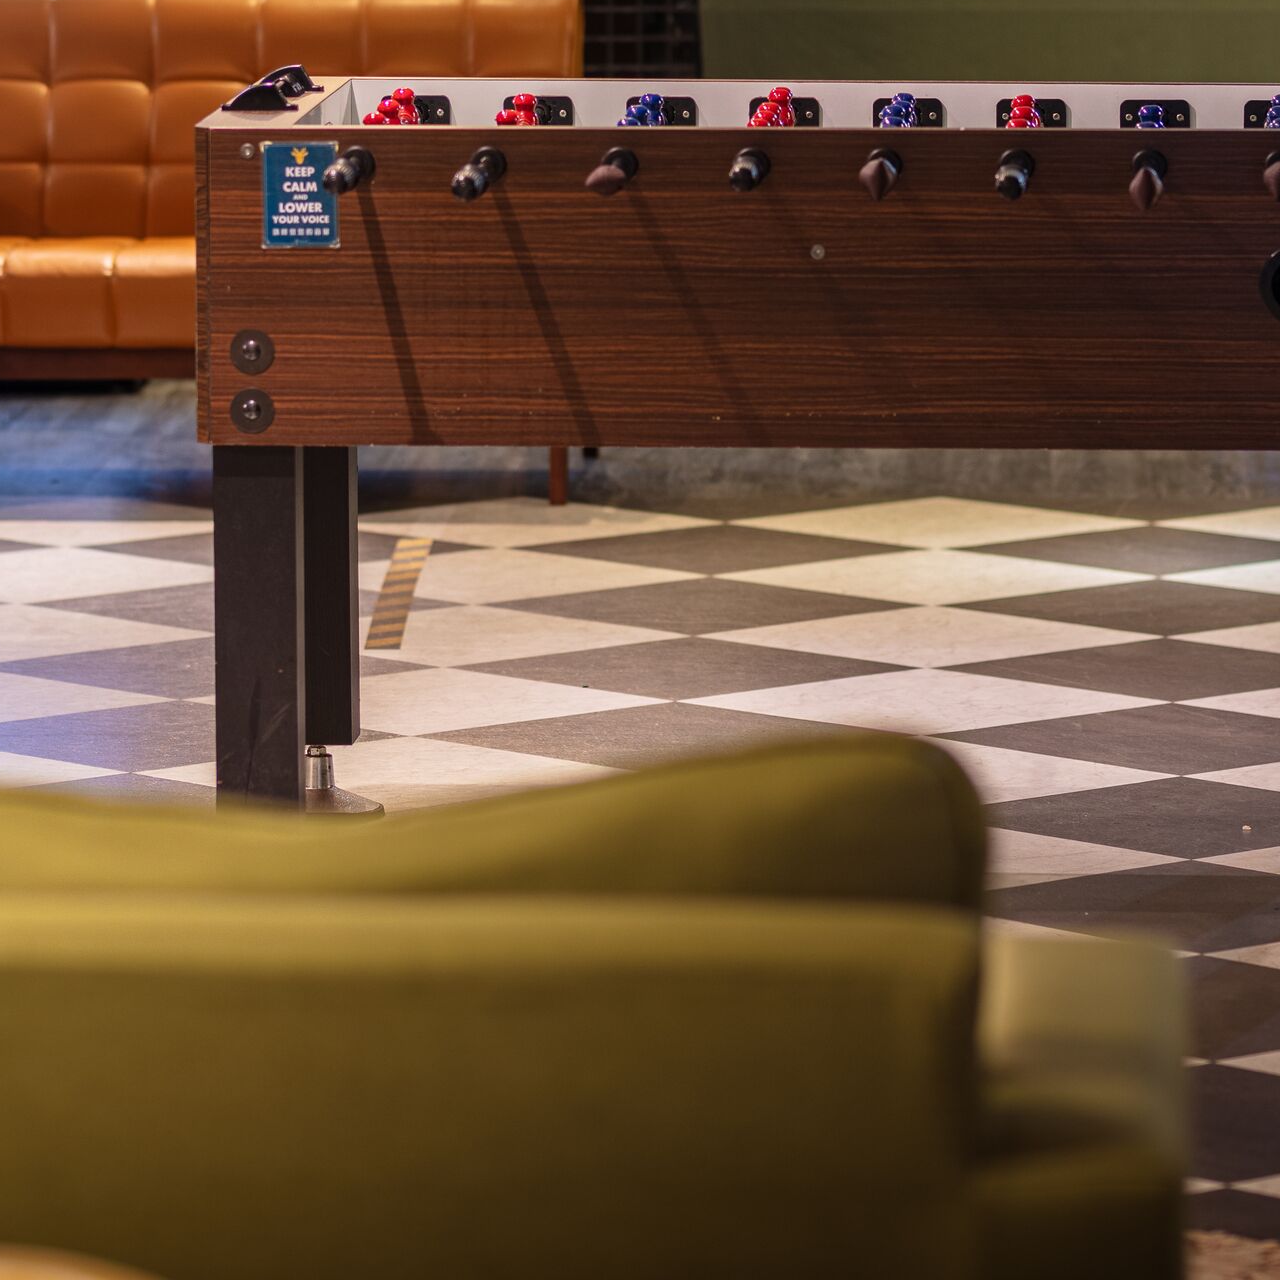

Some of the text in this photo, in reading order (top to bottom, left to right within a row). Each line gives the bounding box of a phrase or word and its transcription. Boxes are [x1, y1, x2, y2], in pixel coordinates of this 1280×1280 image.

[285, 166, 315, 177] KEEP
[282, 181, 318, 192] CALM
[279, 202, 323, 213] LOWER
[272, 215, 330, 224] YOUR VOICE
